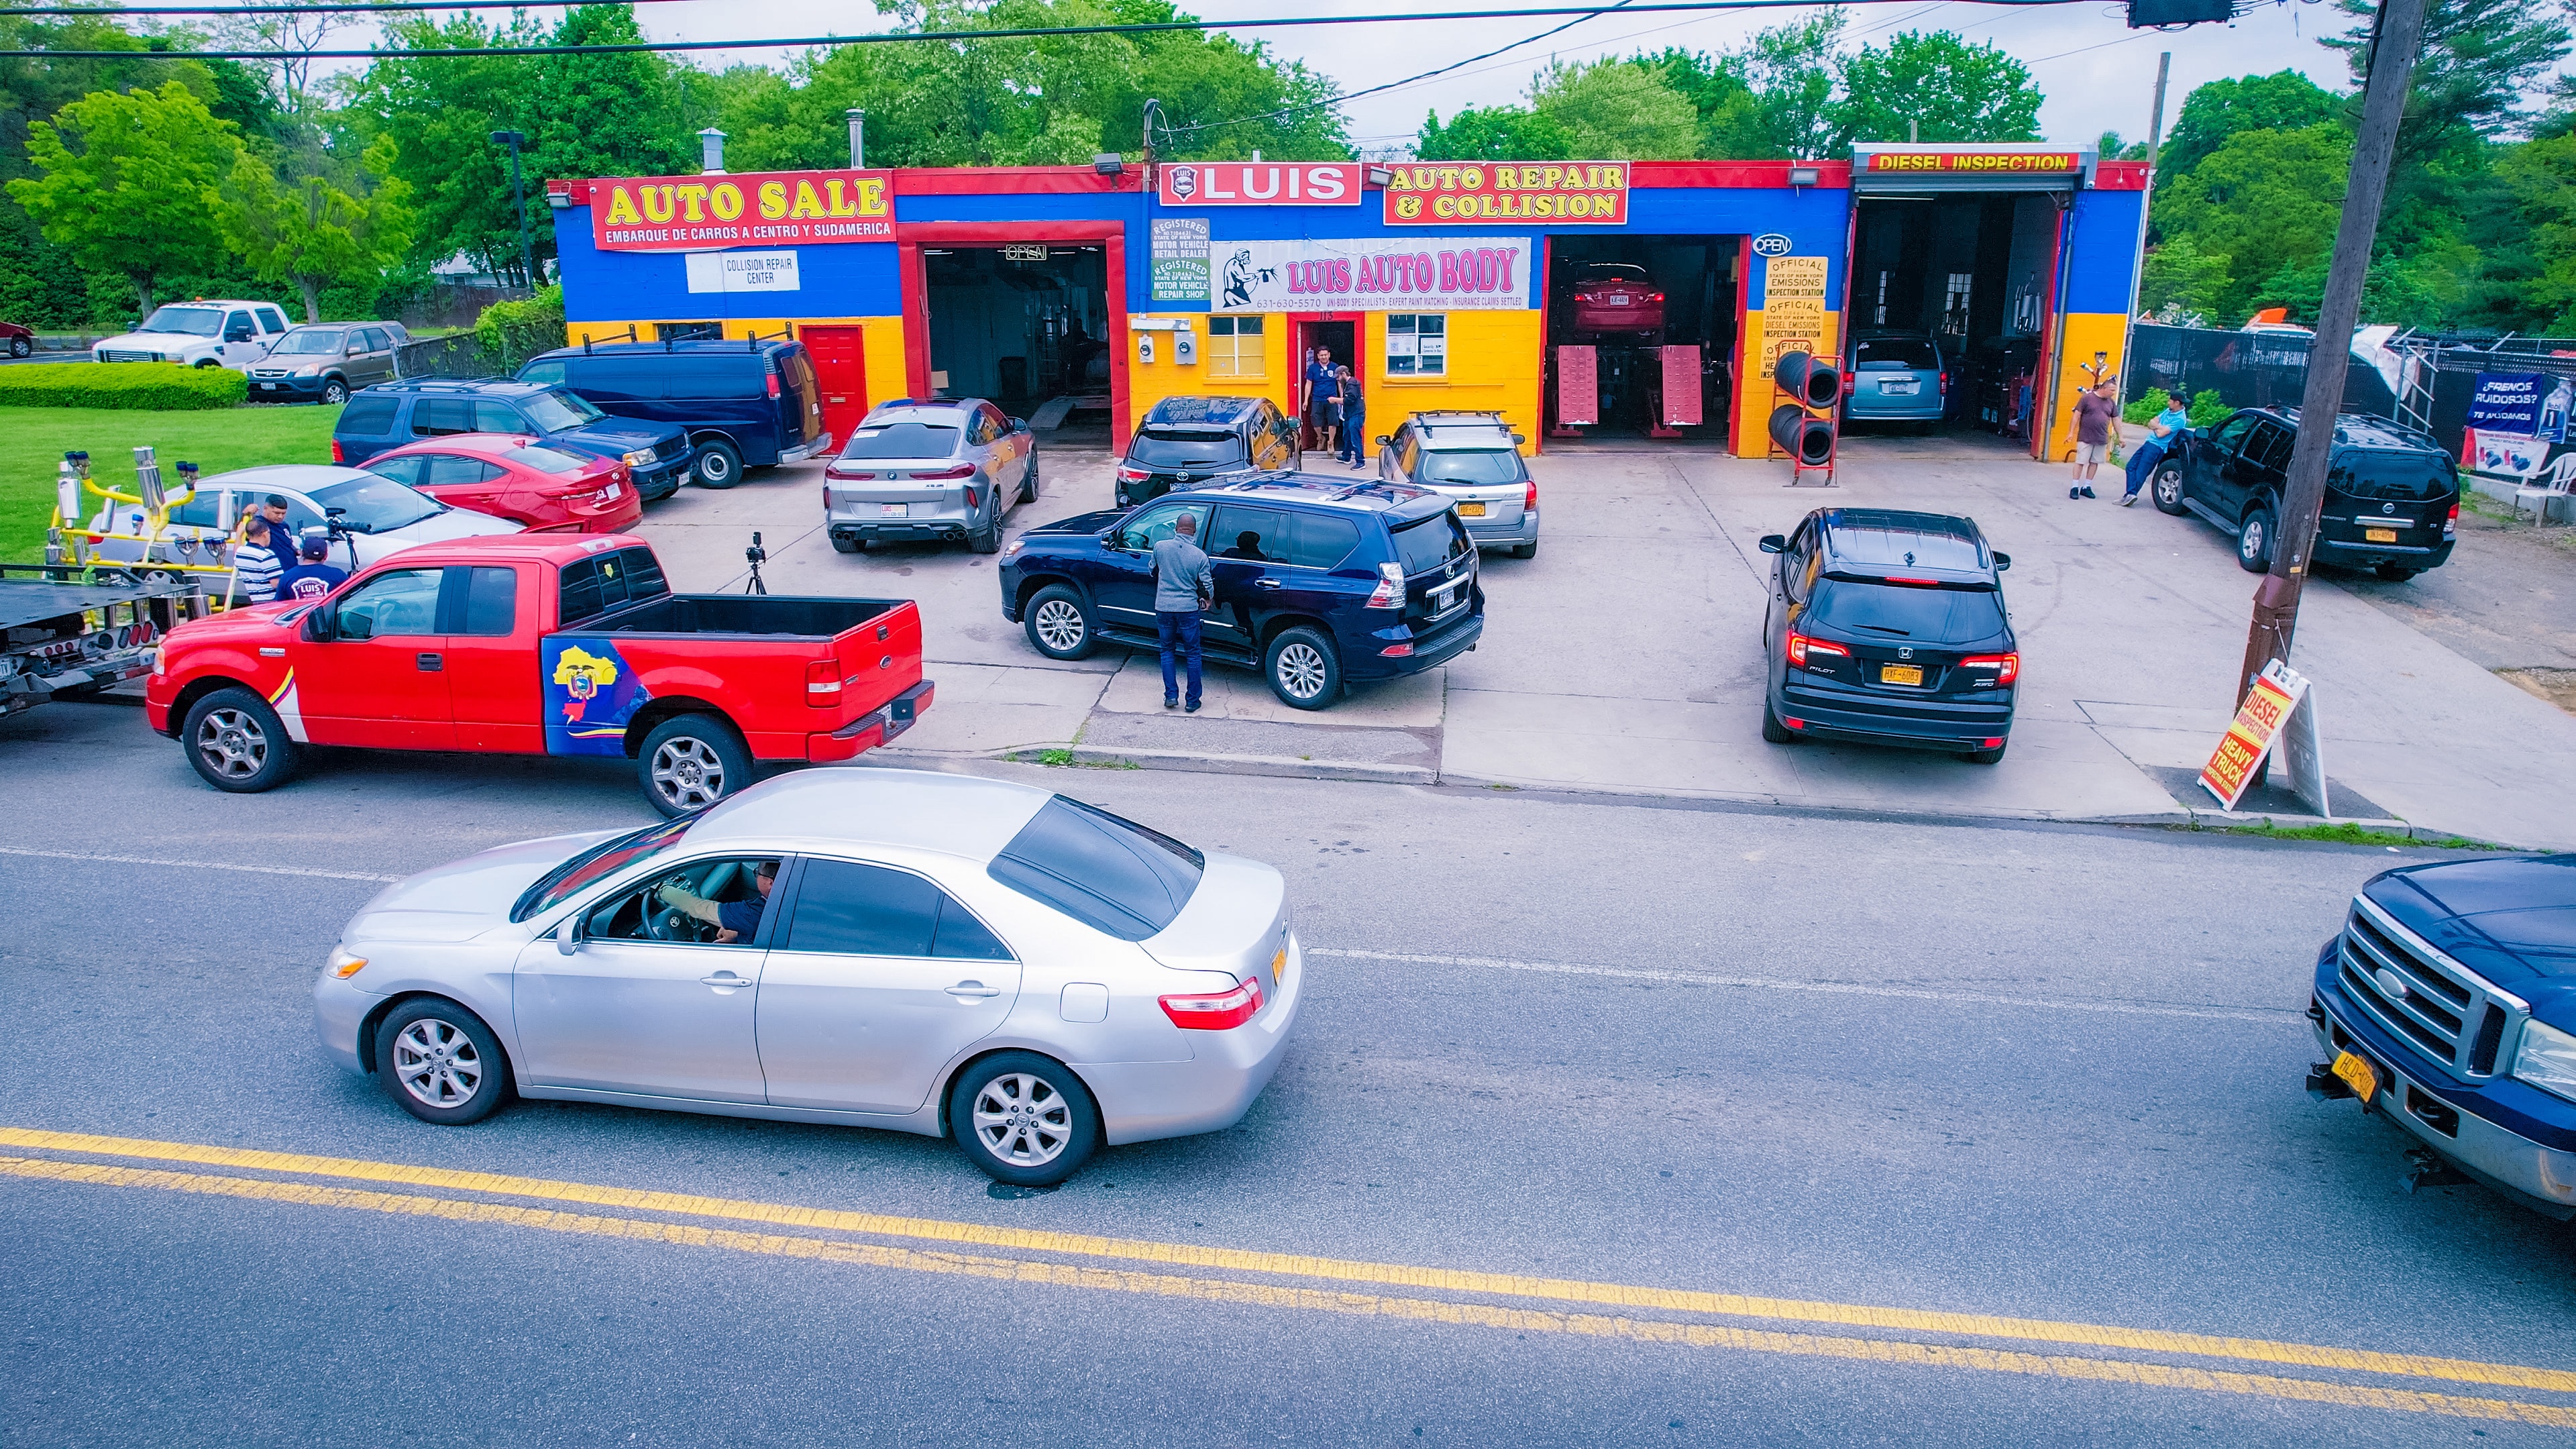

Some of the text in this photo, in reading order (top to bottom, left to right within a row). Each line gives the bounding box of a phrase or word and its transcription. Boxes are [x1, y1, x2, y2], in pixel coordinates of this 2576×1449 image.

[1878, 155, 2069, 170] DIESEL INSPECTION
[1204, 167, 1346, 199] LUIS
[1387, 166, 1626, 191] AUTO REPAIR
[605, 177, 888, 225] AUTO SALE
[1395, 194, 1619, 219] & COLLISION
[605, 222, 891, 243] EMBARQUE DE CARROS A CENTRO Y SUDAMERICA
[1153, 219, 1206, 235] REGISTERED
[1152, 241, 1208, 249] MOTOR VEHICLE
[1755, 239, 1788, 252] OPEN
[1008, 246, 1044, 258] OPEN
[1155, 249, 1207, 258] RETAIL DEALER
[727, 258, 792, 272] COLLISION REPAIR
[1154, 260, 1207, 276] REGISTERED
[1286, 247, 1519, 294] LUIS AUTO BODY
[1772, 259, 1823, 271] OFFICIAL
[747, 272, 774, 284] CENTER
[1772, 278, 1820, 286] EMISSIONS
[1154, 281, 1208, 290] MOTOR VEHICLE
[1159, 290, 1205, 299] REPAIR SHOP
[1256, 299, 1321, 308] 631-630-5570
[1389, 298, 1407, 306] EXPERT
[1409, 297, 1422, 306] PAINT
[1424, 297, 1448, 306] MATCHING
[1453, 297, 1480, 306] INSURANCE
[1481, 297, 1499, 306] CLAIMS
[1501, 297, 1521, 306] SETTLED
[1770, 301, 1819, 313] OFFICIAL
[2483, 382, 2533, 392] ¿FRENOS
[2475, 393, 2537, 404] RUIDOSOS?
[301, 584, 320, 593] LUIS
[1809, 665, 1835, 674] PILOT
[2244, 690, 2281, 730] DIESEL
[2236, 711, 2271, 743] INSPECTION
[2221, 736, 2254, 769] HEAVY
[2213, 750, 2245, 786] TRUCK
[2205, 765, 2224, 786] INSPECTION
